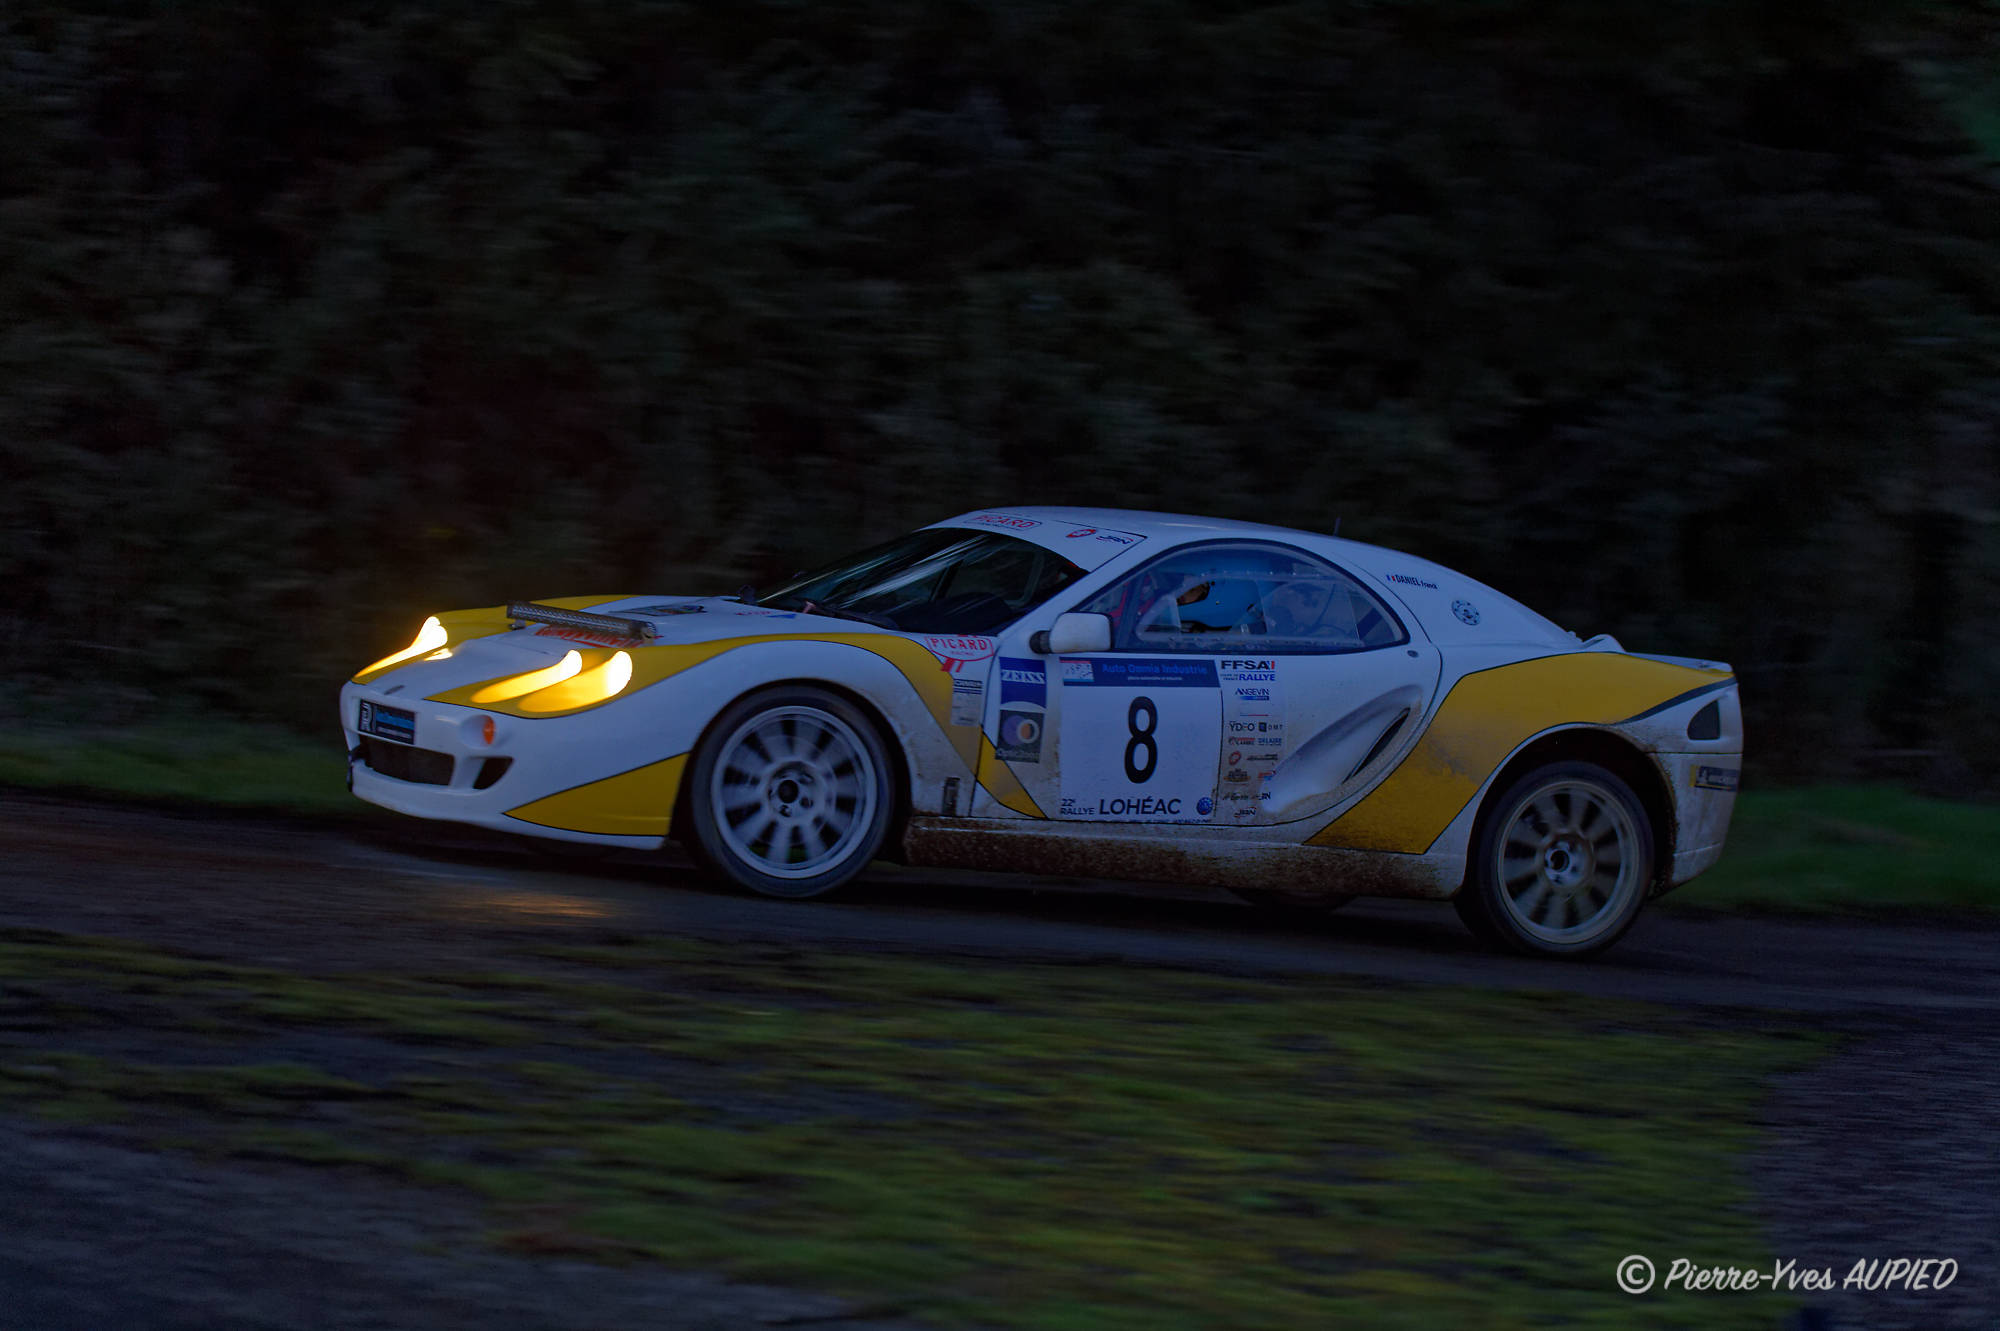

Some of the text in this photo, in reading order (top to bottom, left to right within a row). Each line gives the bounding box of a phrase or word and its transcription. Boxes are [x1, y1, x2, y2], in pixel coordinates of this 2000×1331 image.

[1395, 574, 1420, 586] DANIEL
[930, 637, 988, 651] PICARD
[1221, 660, 1269, 670] FFSA
[1000, 669, 1045, 684] ZEISS
[1125, 696, 1158, 783] 8
[1061, 807, 1095, 815] RALLYE
[1100, 795, 1182, 815] LOHÉAC
